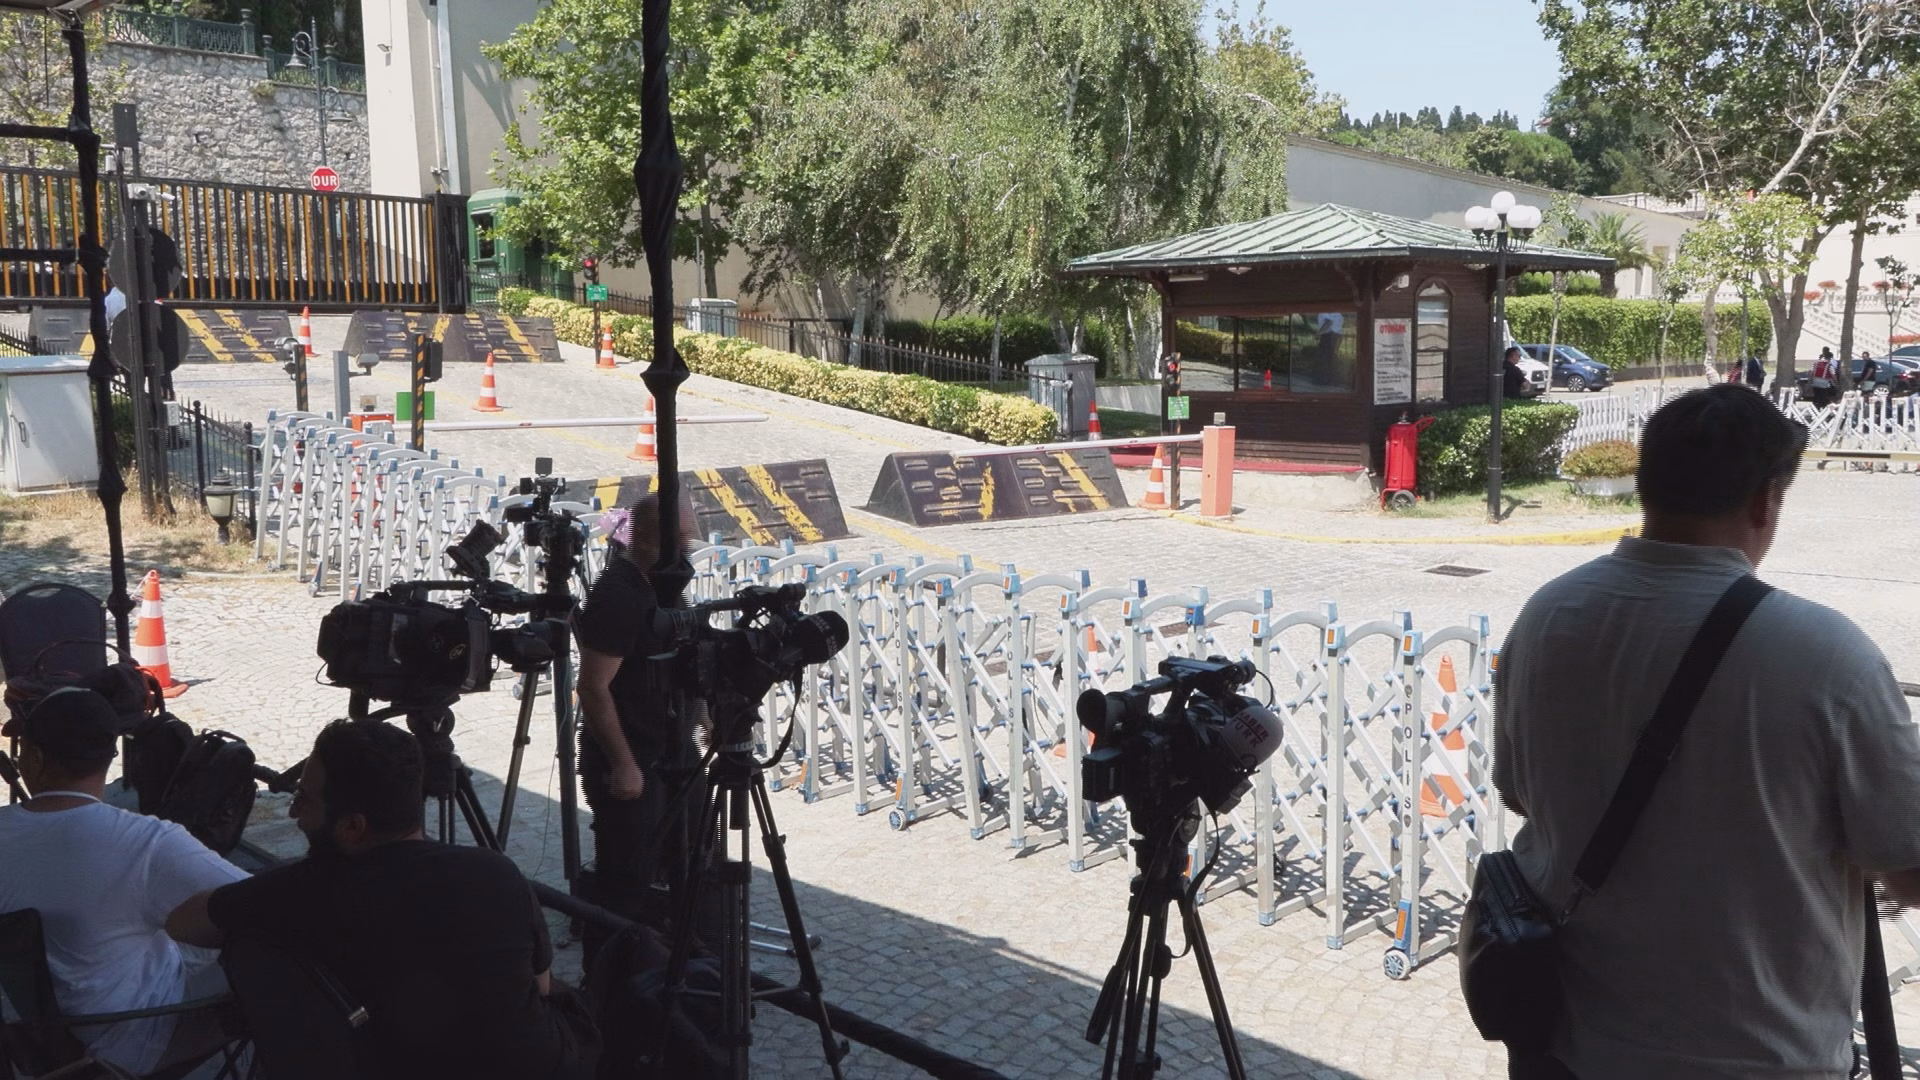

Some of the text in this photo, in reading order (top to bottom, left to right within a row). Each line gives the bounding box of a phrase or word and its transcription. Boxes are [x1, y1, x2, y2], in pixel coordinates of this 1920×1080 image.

[313, 175, 337, 187] DUR
[894, 623, 903, 702] POLIS
[1006, 632, 1014, 718] POLIS
[1404, 703, 1413, 809] POLIS
